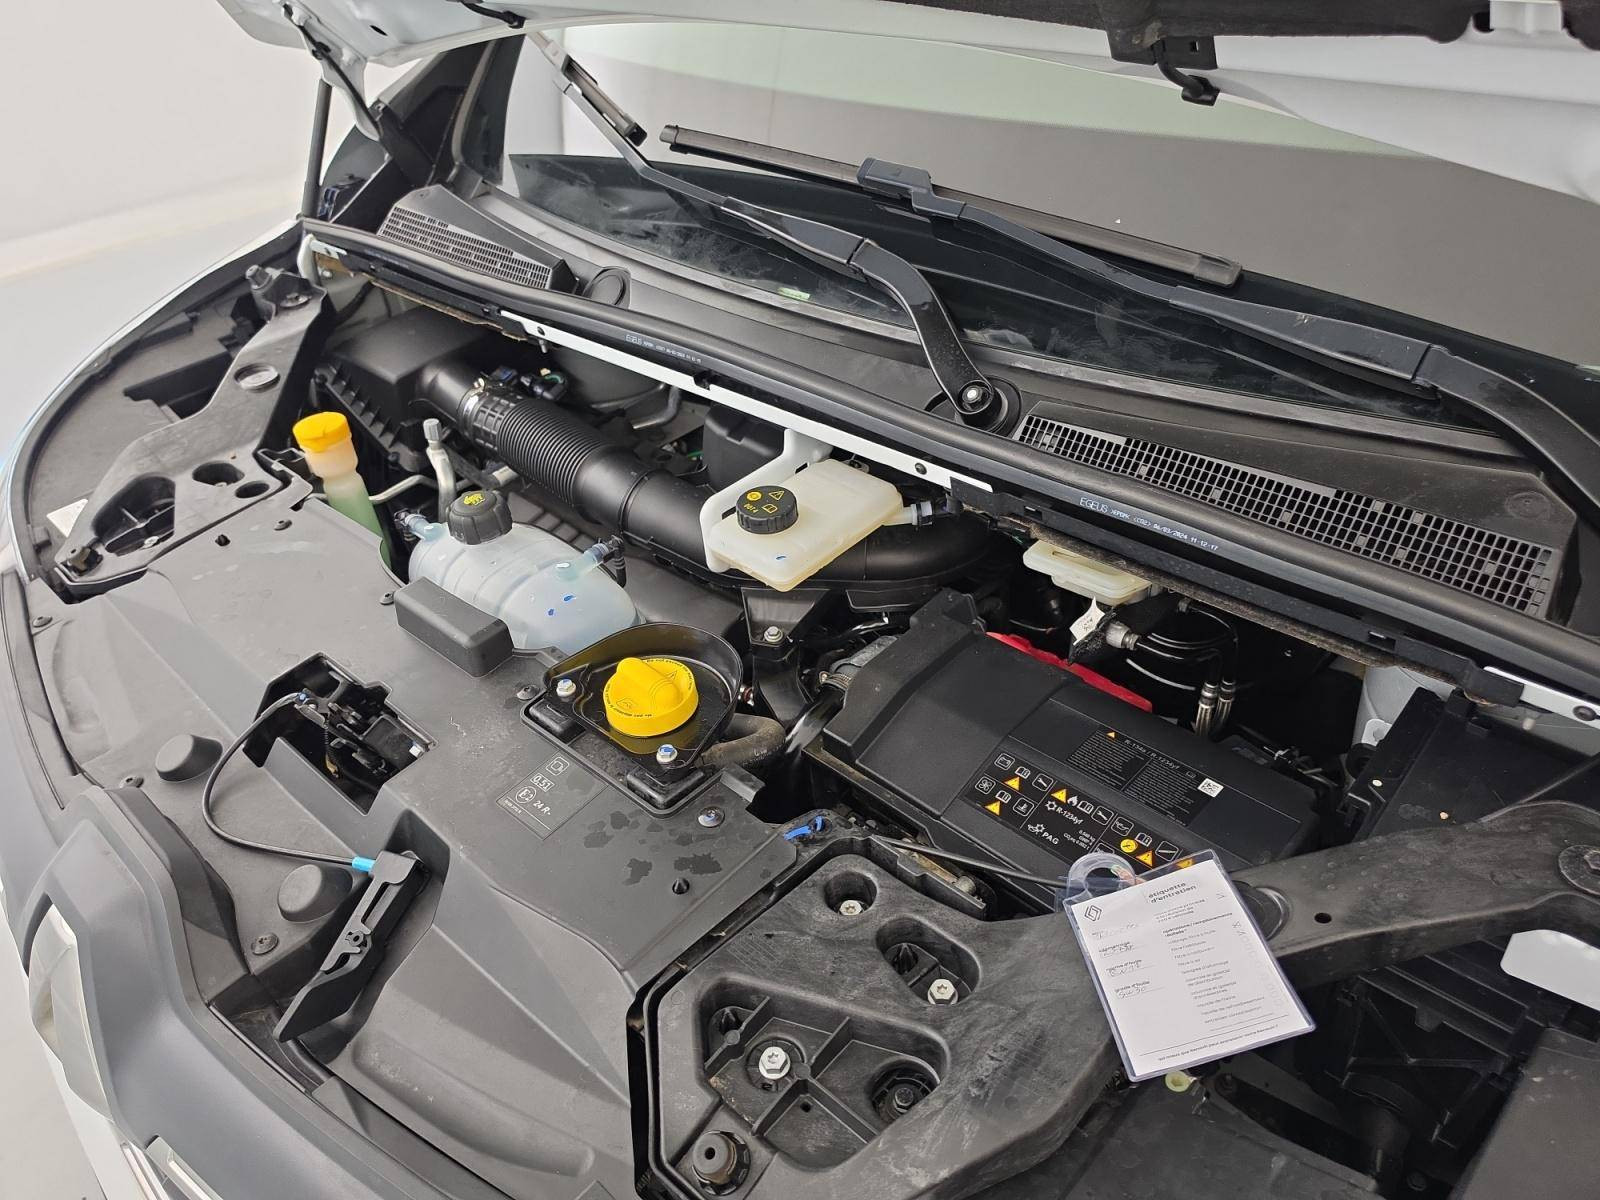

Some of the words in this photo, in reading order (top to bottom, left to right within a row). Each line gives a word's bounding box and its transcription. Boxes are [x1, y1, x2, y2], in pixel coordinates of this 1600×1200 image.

[1080, 497, 1108, 514] EGEUS
[1055, 806, 1084, 825] R-1234yf
[1042, 831, 1060, 845] PAG
